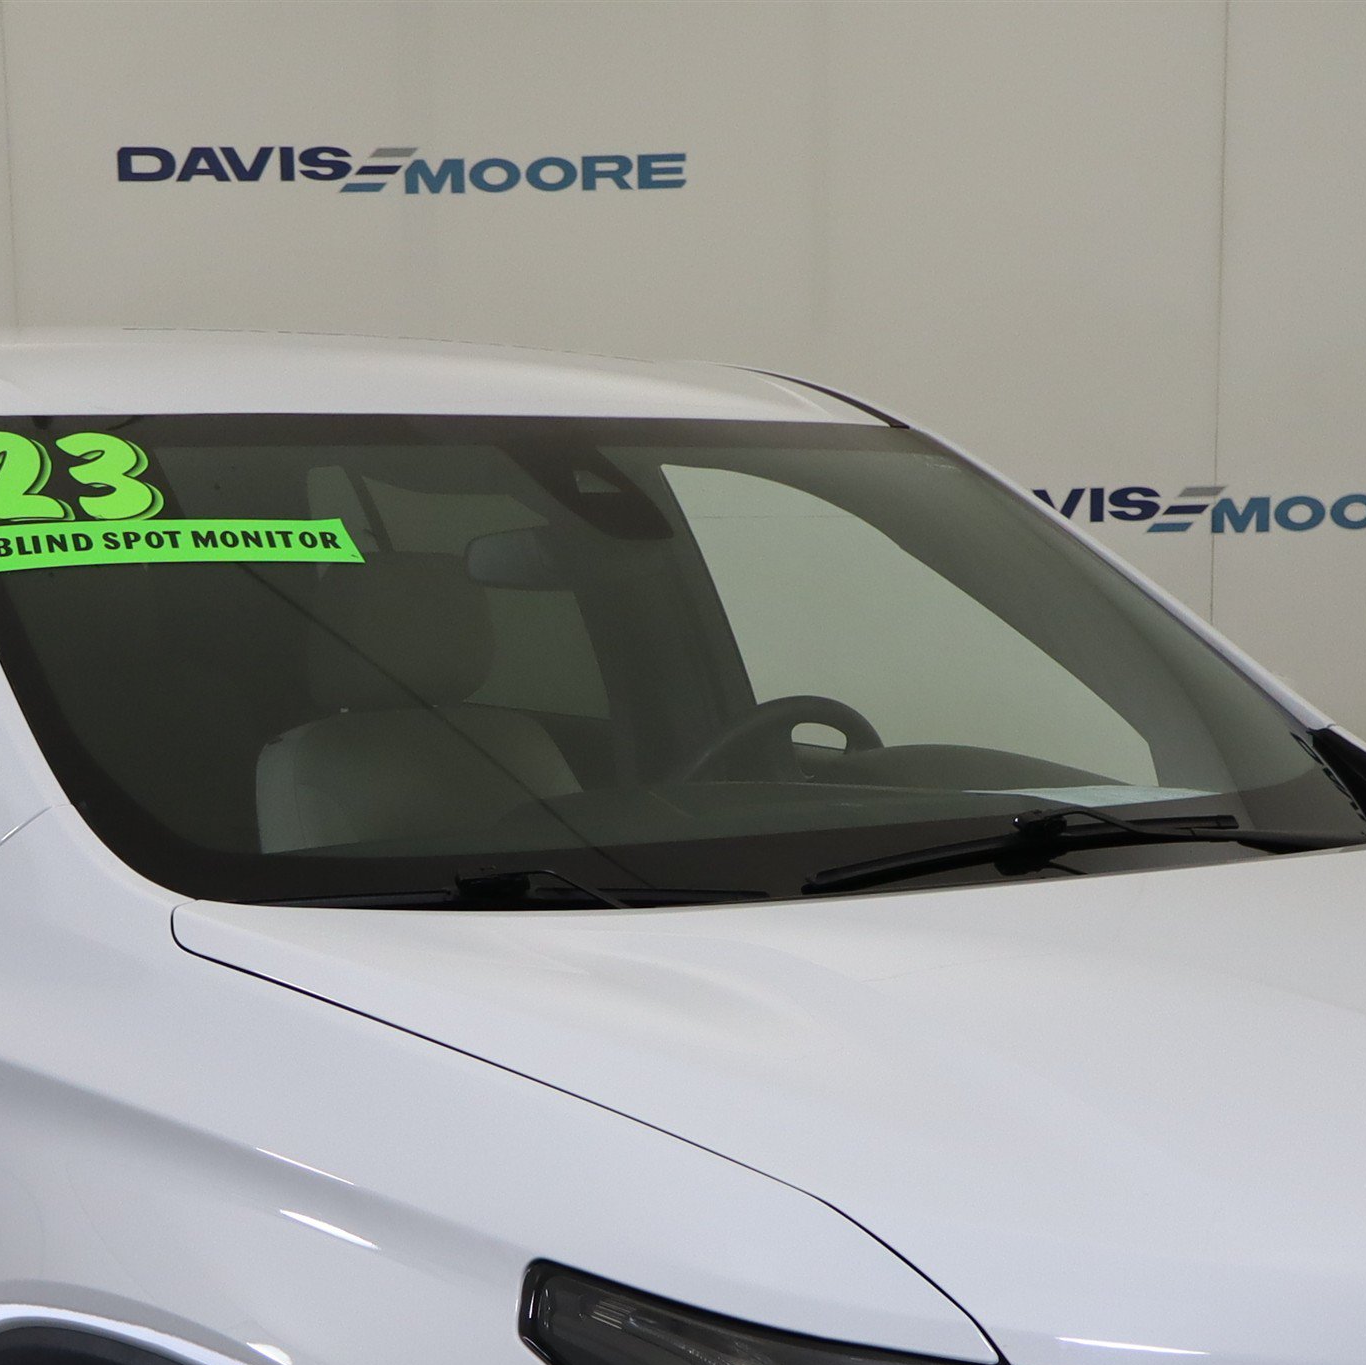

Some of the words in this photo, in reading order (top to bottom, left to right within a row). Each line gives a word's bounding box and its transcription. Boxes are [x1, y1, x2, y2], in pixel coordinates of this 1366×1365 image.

[117, 146, 352, 182] DAVIS
[404, 153, 687, 194] MOORE
[103, 531, 181, 551] SPOT
[192, 531, 342, 549] MONITOR
